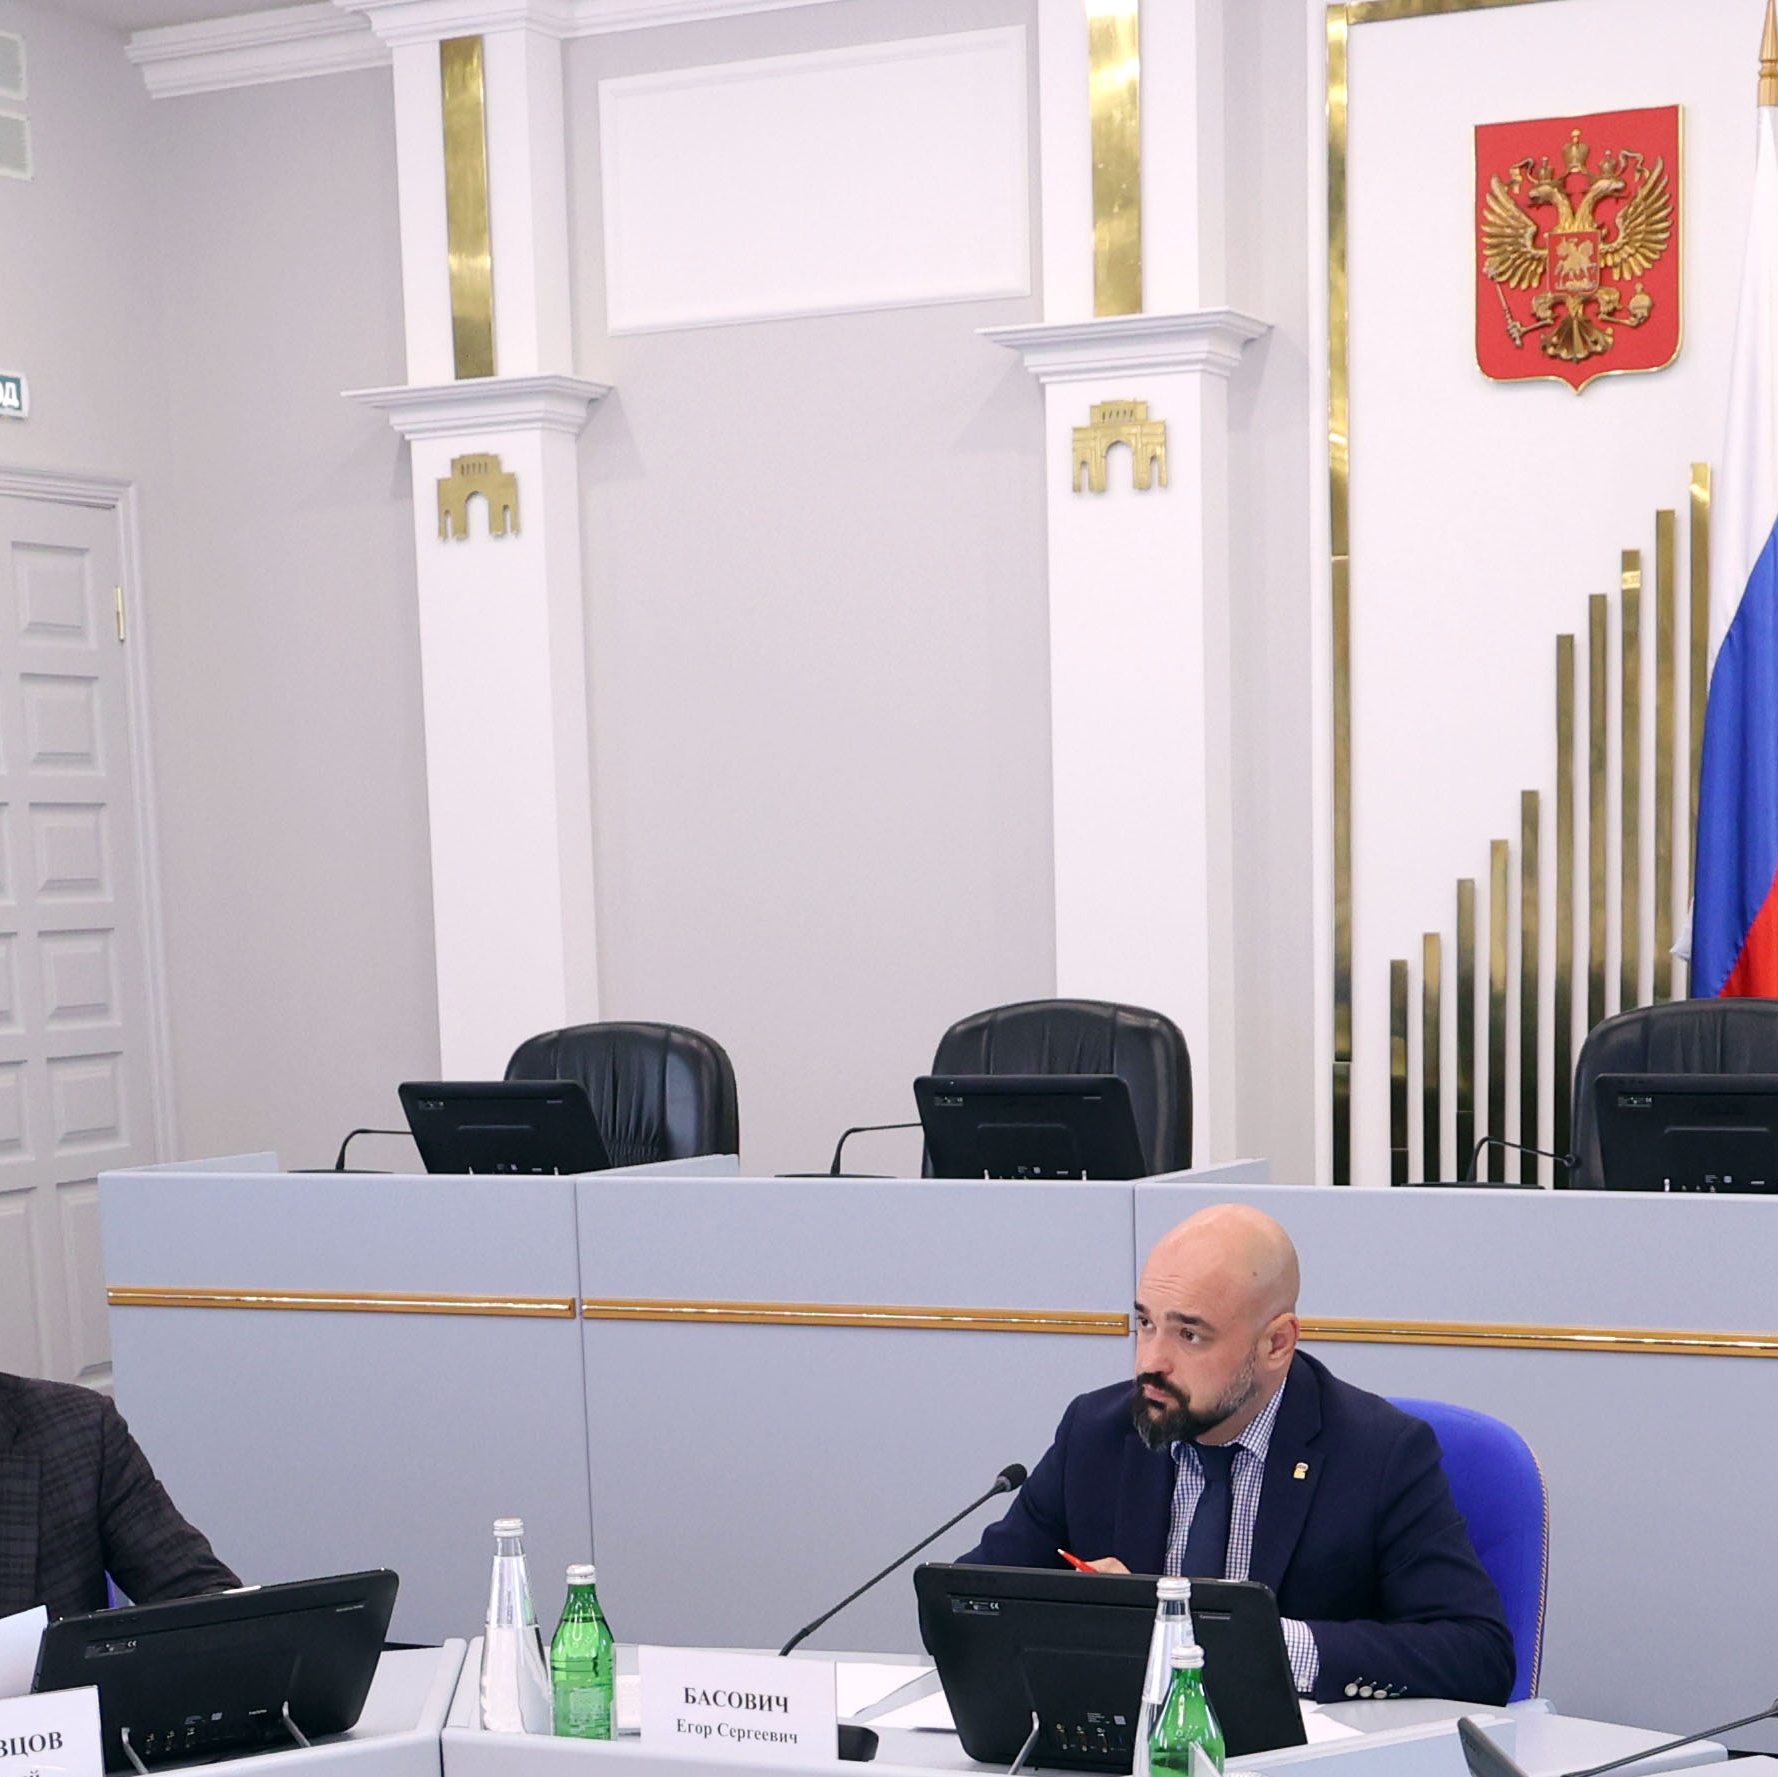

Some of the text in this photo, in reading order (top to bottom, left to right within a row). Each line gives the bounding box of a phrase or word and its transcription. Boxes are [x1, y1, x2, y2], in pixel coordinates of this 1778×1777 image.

[683, 1686, 790, 1714] БАСОВИЧ
[676, 1718, 799, 1744] Егор Сергеевич
